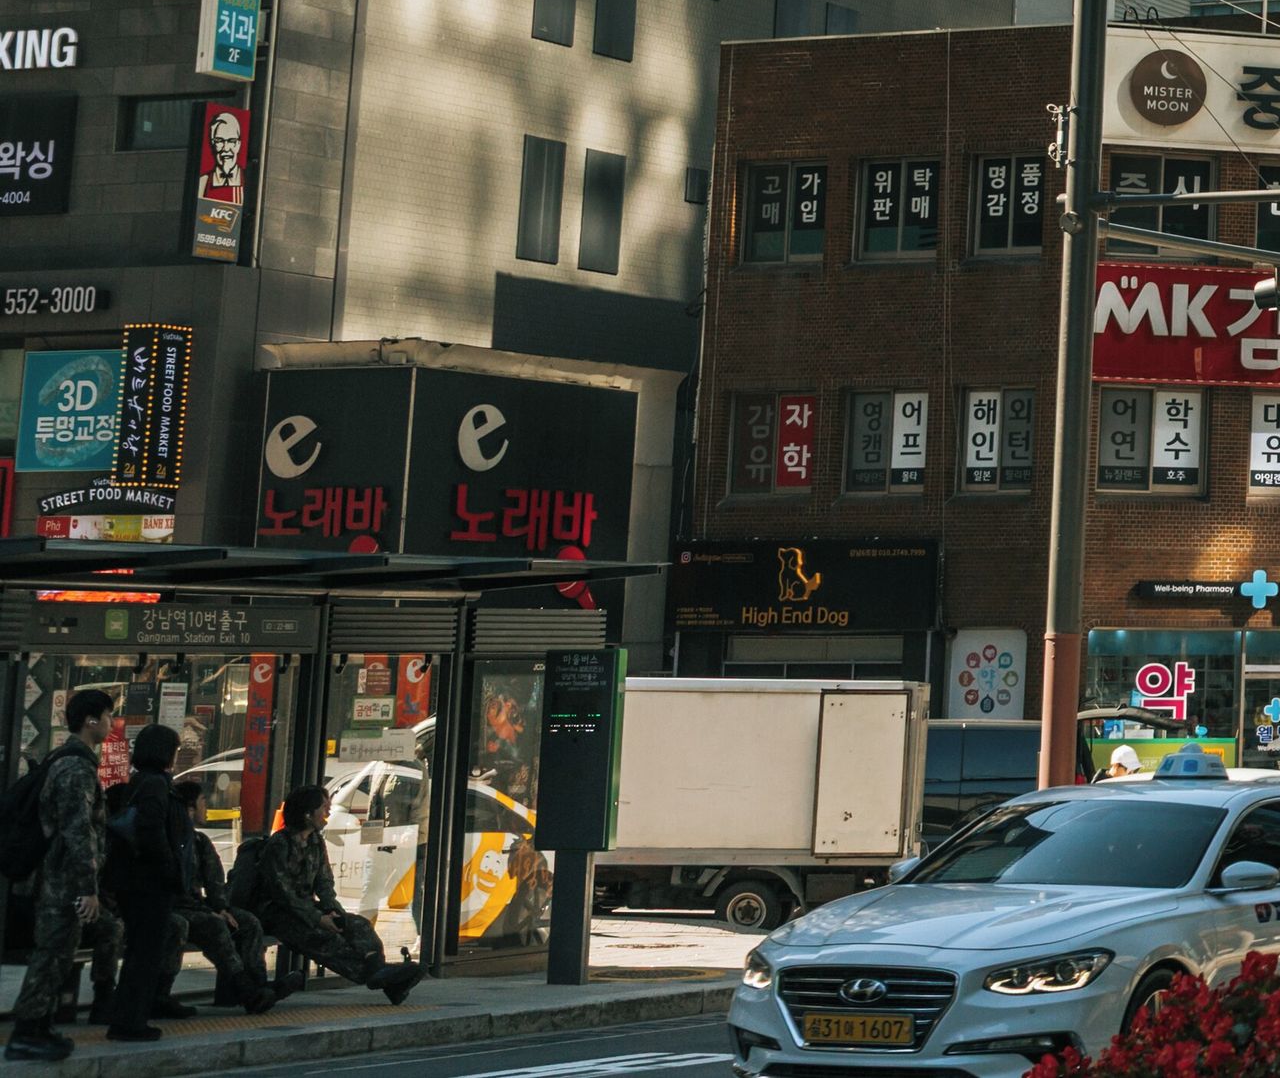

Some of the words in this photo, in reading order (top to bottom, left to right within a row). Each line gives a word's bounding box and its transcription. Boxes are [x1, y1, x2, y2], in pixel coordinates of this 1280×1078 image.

[217, 10, 255, 48] 치과
[228, 48, 241, 63] 2F
[1143, 84, 1193, 100] MISTER
[1146, 98, 1190, 112] MOON
[0, 139, 55, 180] 왁싱
[210, 207, 234, 221] KFC
[5, 286, 96, 314] 552-3000
[166, 346, 177, 381] STREET
[57, 380, 98, 412] 3D
[162, 382, 175, 413] FOOD
[35, 415, 116, 443] 투명교정
[157, 416, 171, 459] MARKET
[973, 469, 992, 483] 일본
[1104, 468, 1142, 481] 뉴질랜드
[1166, 469, 1187, 482] 호주
[41, 489, 86, 512] STREET
[89, 487, 121, 501] FOOD
[125, 489, 175, 510] MARKET
[257, 486, 388, 537] 노래바
[450, 484, 598, 550] 노래바
[1154, 584, 1194, 596] Well-being
[1195, 584, 1235, 596] Pharmacy
[142, 609, 248, 632] 강남역10번출구
[741, 606, 777, 627] High
[782, 608, 813, 624] End
[817, 608, 849, 626] Dog
[137, 632, 180, 645] Gangnam
[184, 633, 215, 644] Station
[219, 633, 236, 644] Exit
[240, 633, 250, 644] 10
[1135, 661, 1196, 721] 약
[355, 704, 373, 717] 금연
[860, 1019, 904, 1039] 1607
